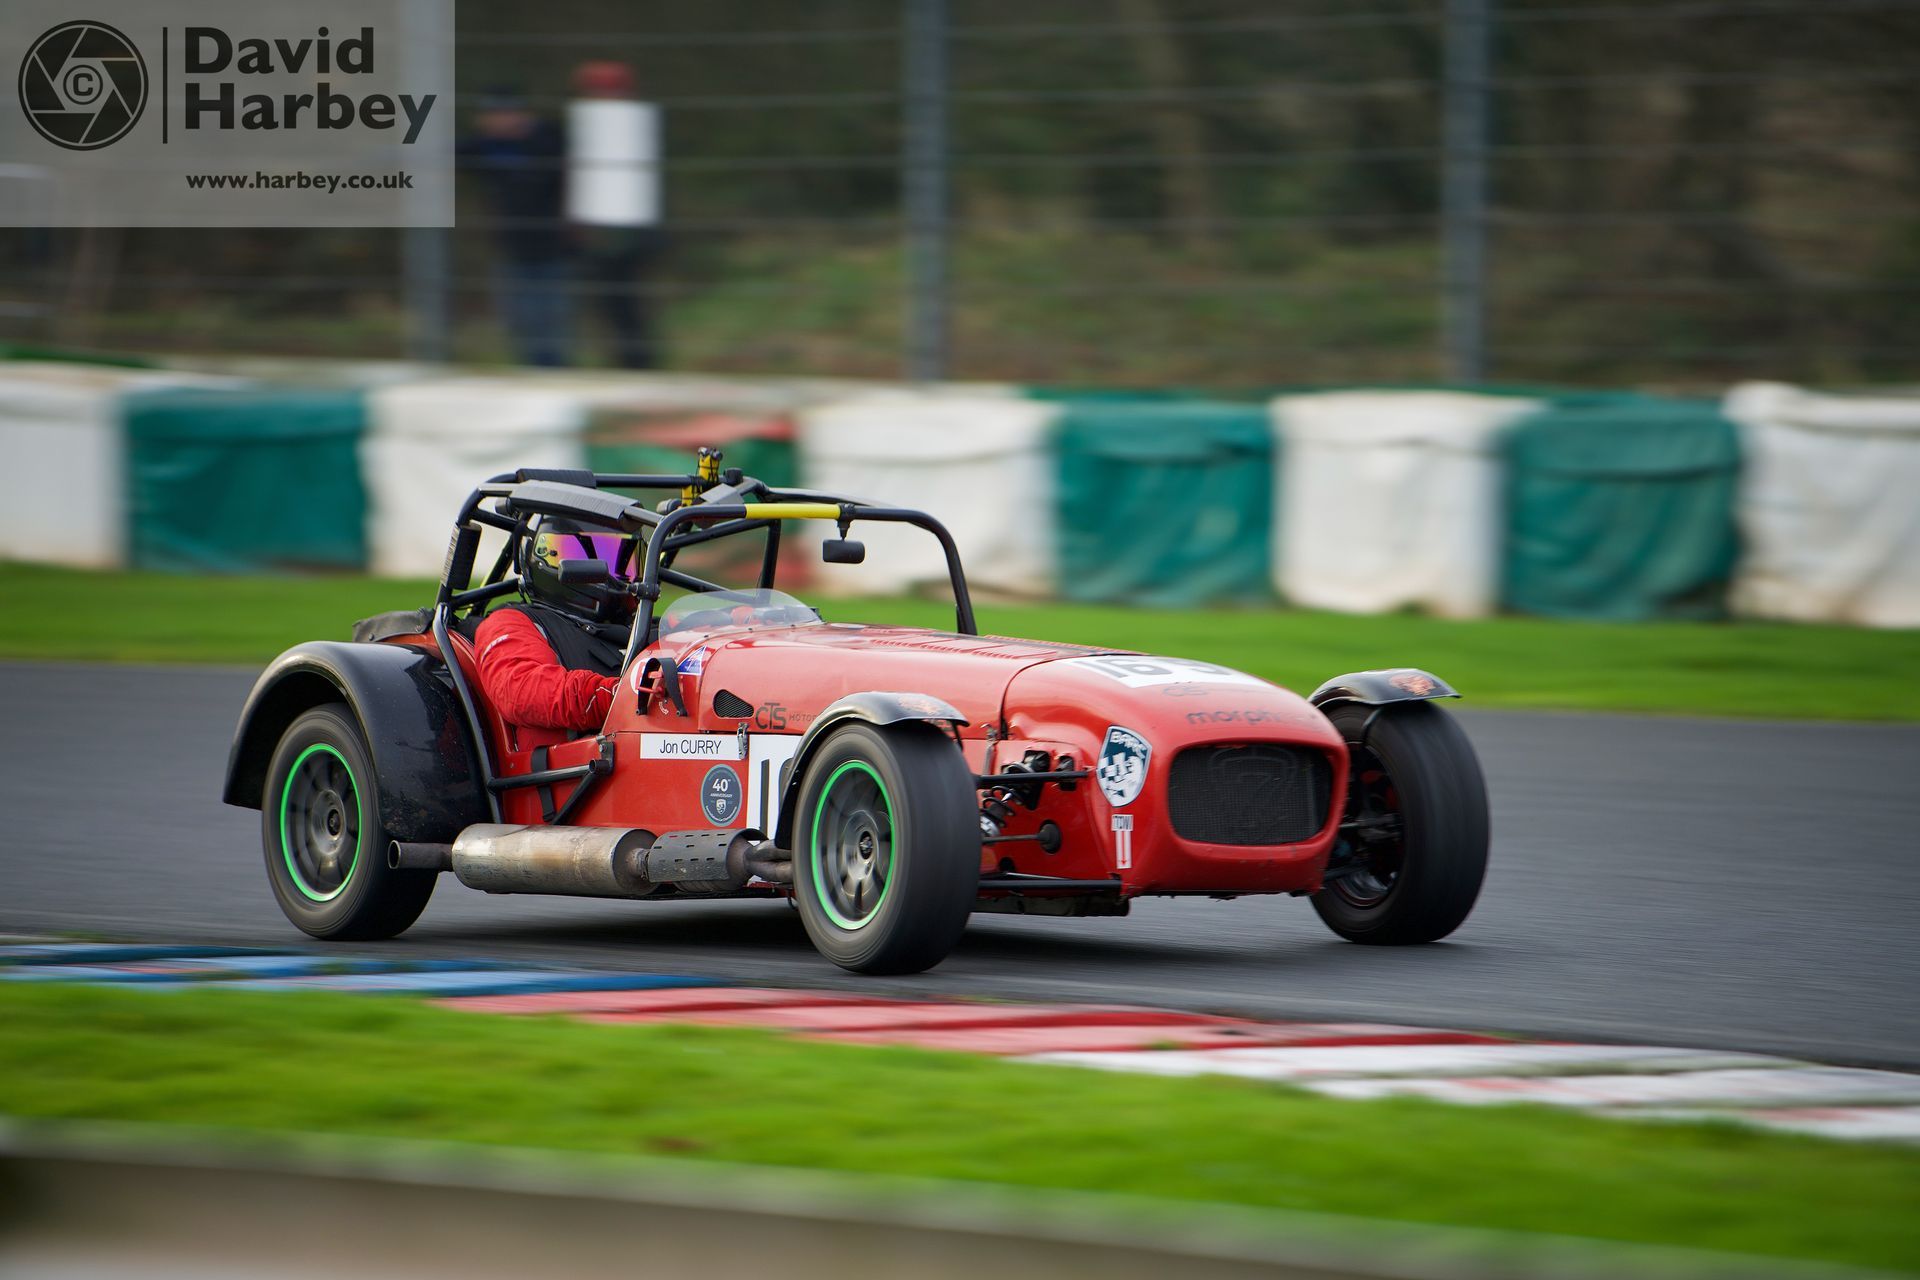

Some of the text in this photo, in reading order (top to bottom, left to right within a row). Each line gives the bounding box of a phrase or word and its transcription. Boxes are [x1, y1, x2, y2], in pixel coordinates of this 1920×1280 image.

[755, 702, 788, 730] CTS
[659, 739, 722, 755] Jon CURRY
